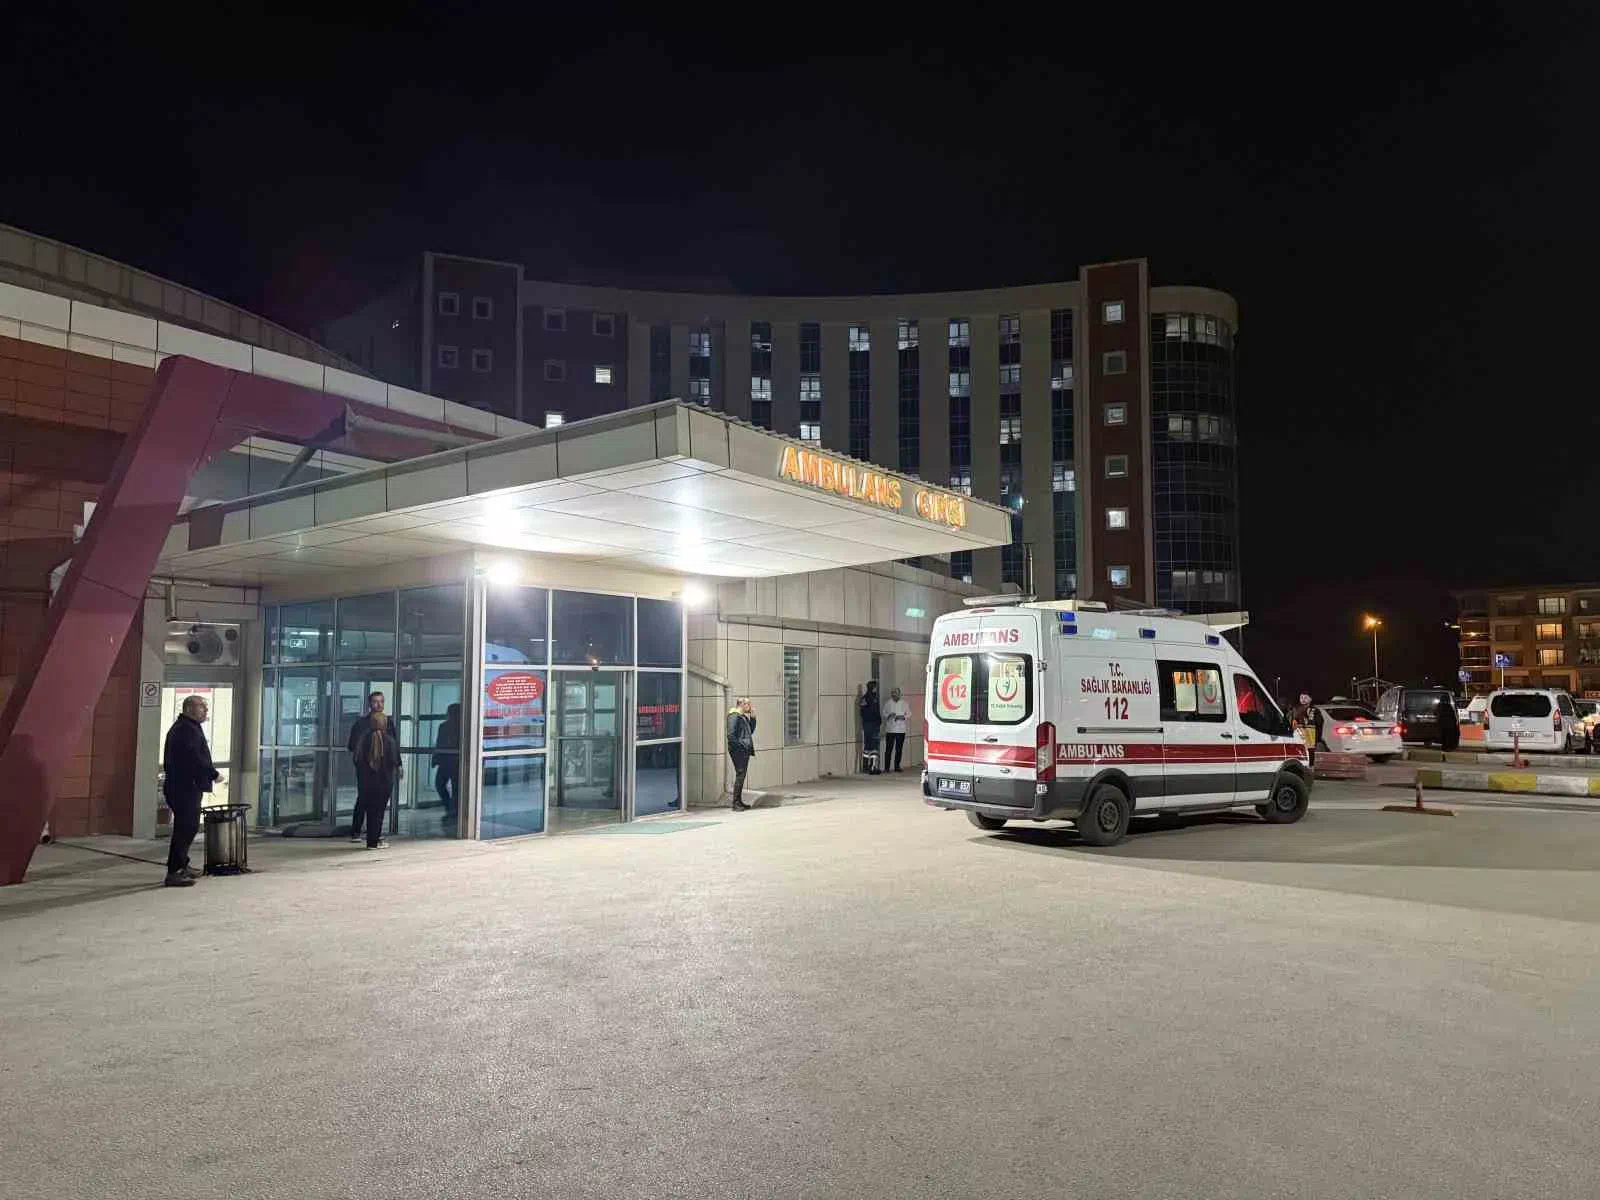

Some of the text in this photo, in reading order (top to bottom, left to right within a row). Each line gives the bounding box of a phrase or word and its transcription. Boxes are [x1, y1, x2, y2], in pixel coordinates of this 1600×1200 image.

[778, 446, 902, 510] AMBULANS
[1108, 662, 1124, 677] T.C.
[948, 684, 967, 699] 112
[1080, 676, 1152, 695] SAĞLIK BAKANLIĞI
[1104, 697, 1129, 720] 112
[1059, 744, 1125, 758] AMBULANS
